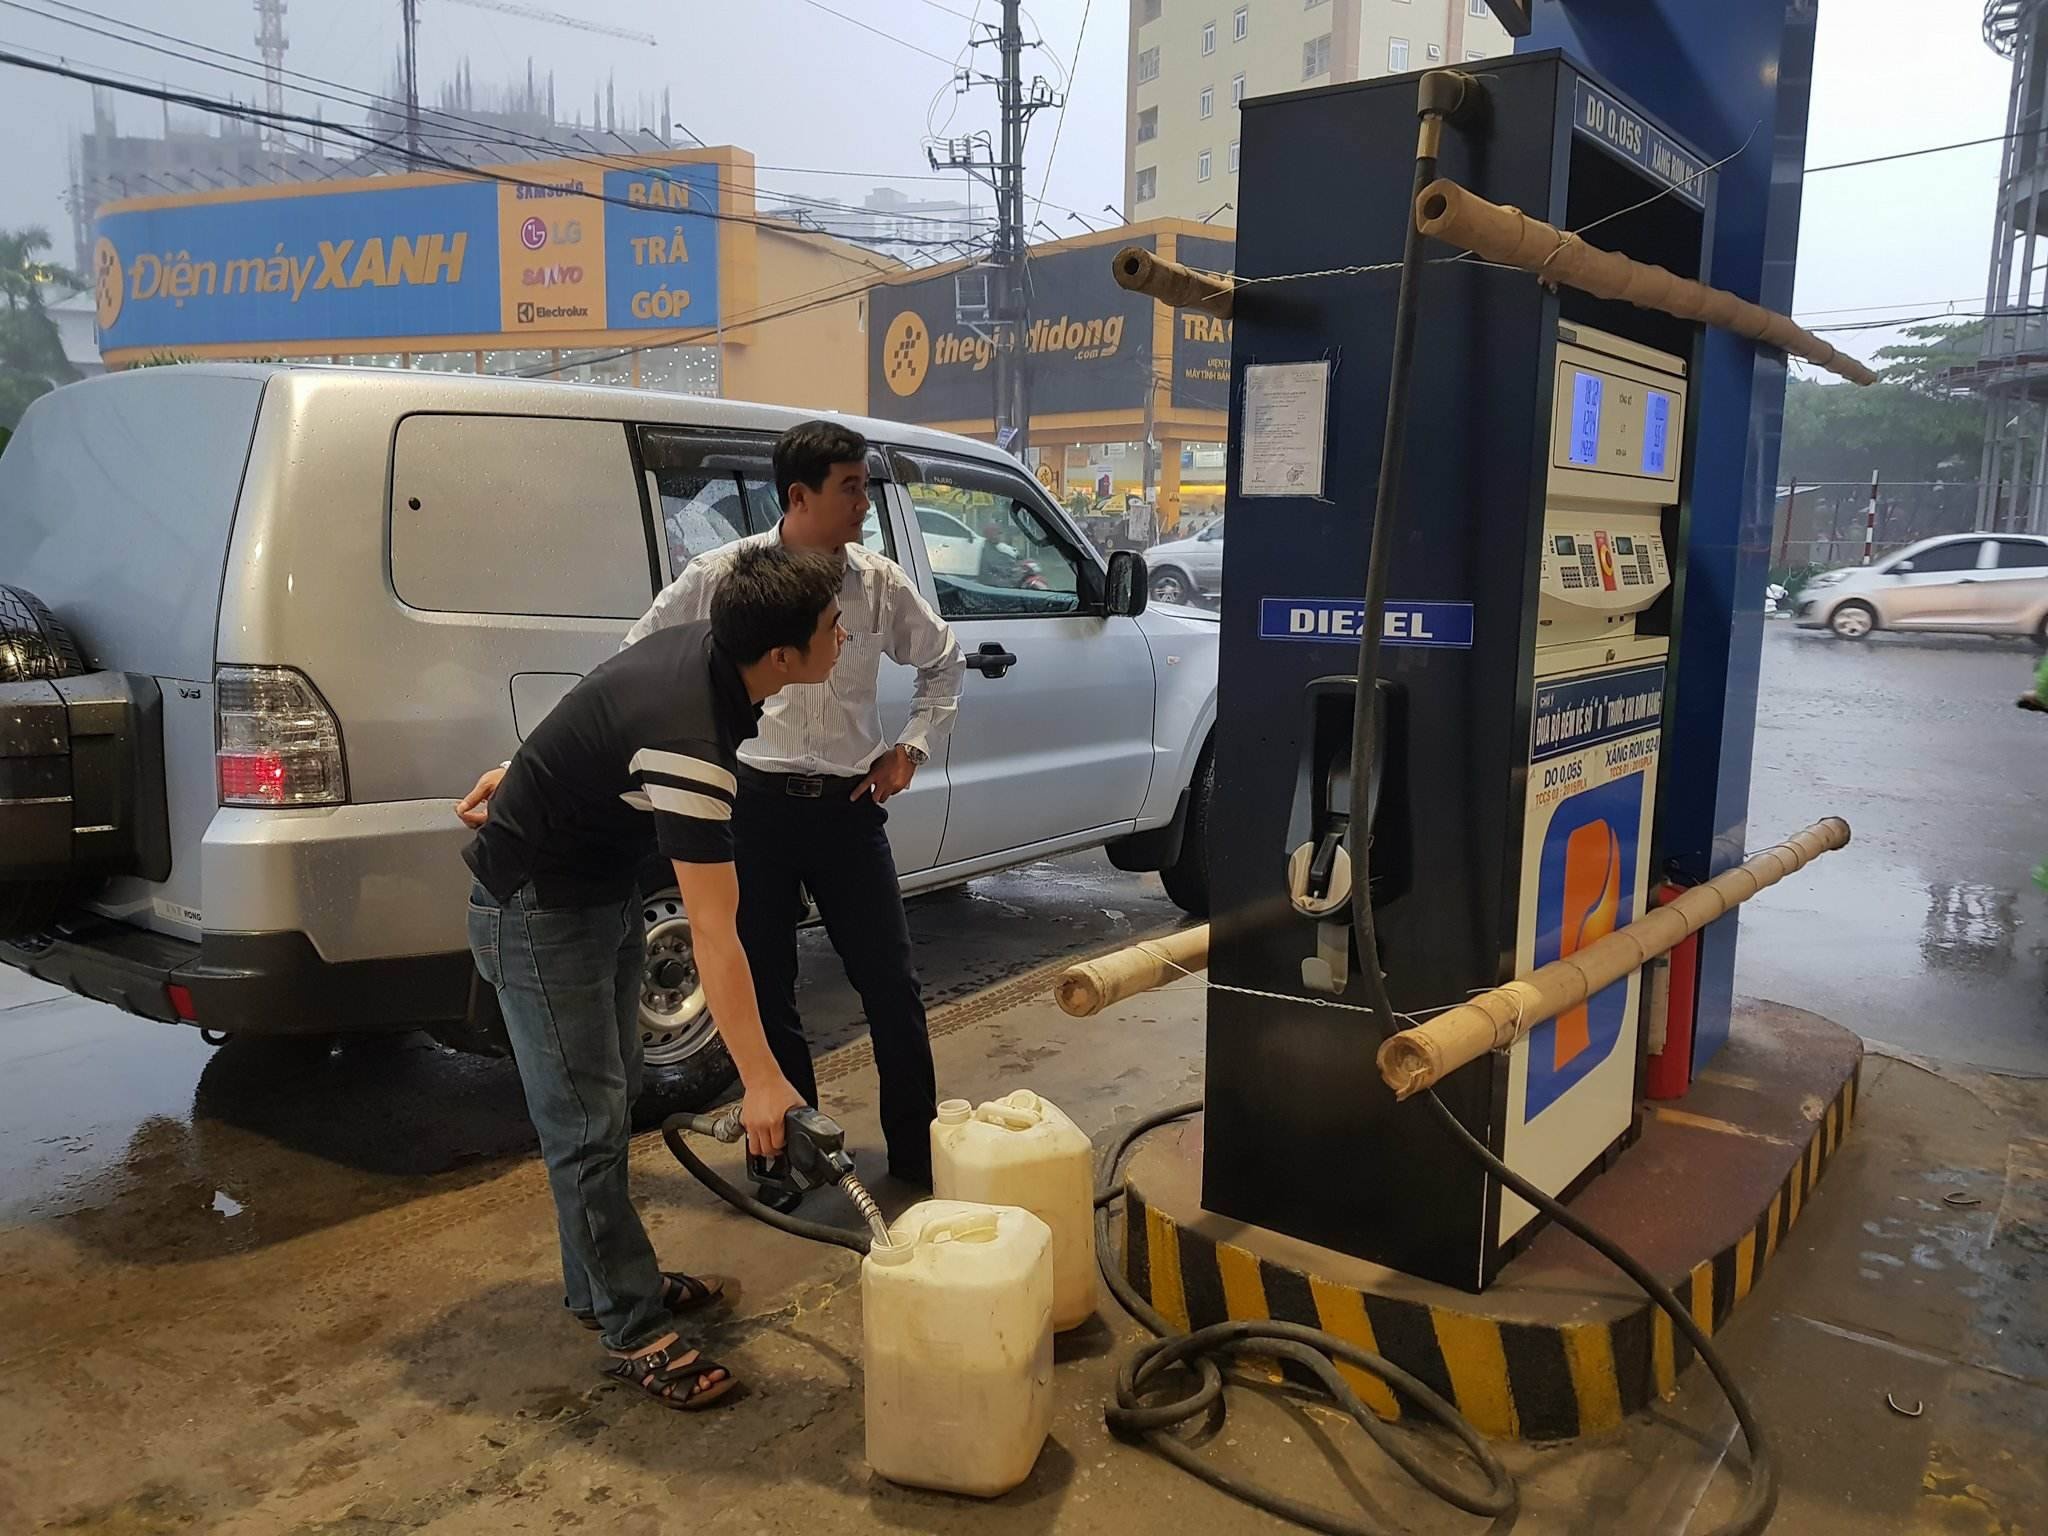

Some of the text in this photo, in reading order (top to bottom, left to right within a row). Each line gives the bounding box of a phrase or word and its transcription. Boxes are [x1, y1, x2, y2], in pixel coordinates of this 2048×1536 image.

[1587, 94, 1642, 155] DO 0,05S
[516, 179, 584, 200] SAMSUNG
[552, 219, 582, 245] LG
[630, 225, 689, 266] TRẢ
[128, 249, 217, 309] Điện
[312, 232, 468, 290] XANH
[536, 304, 588, 318] Electrolux
[631, 283, 691, 319] GÓP
[1544, 760, 1582, 789] DO 0,05S
